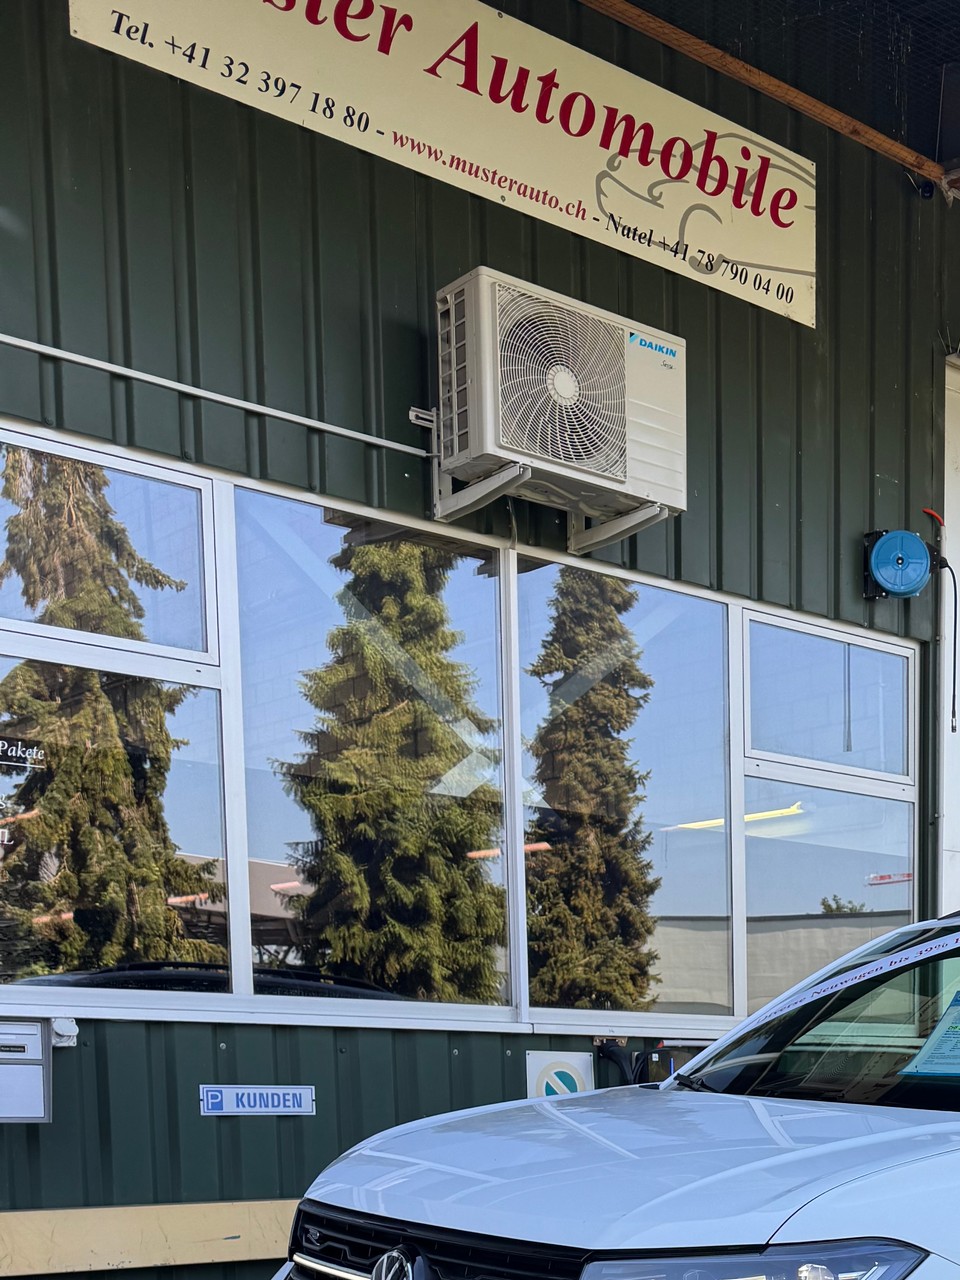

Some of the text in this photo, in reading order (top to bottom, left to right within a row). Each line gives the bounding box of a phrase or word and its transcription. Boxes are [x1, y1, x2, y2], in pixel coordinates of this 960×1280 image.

[423, 21, 798, 228] Automobile
[111, 10, 154, 48] Tel.
[164, 35, 211, 70] +41
[220, 55, 250, 86] 32
[257, 71, 302, 104] 397
[308, 92, 335, 119] 18
[343, 106, 370, 133] 80
[392, 131, 586, 221] www.musterauto.ch
[606, 212, 654, 248] Natel
[658, 236, 689, 262] +41
[697, 249, 715, 272] 78
[721, 259, 748, 285] 790
[753, 273, 771, 295] 04
[777, 283, 794, 304] 00
[639, 338, 677, 358] DAIKIN
[0, 741, 45, 760] Pakete
[811, 965, 884, 998] Neuwagen
[889, 956, 910, 968] bis
[208, 1091, 303, 1110] P KUNDEN
